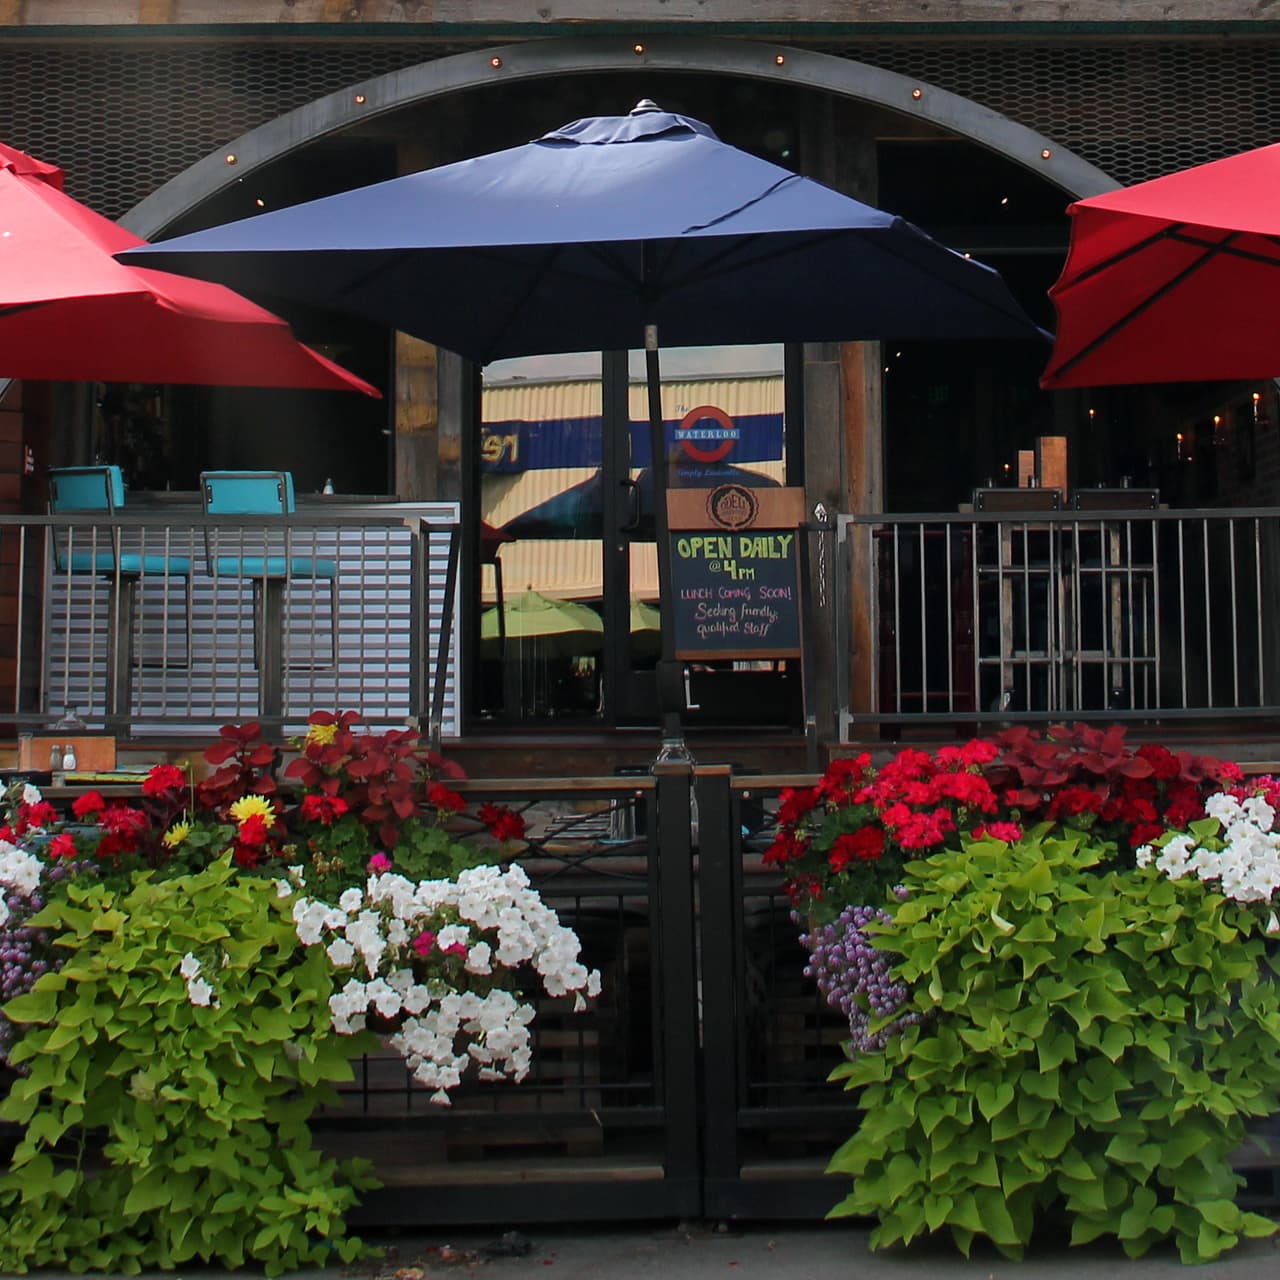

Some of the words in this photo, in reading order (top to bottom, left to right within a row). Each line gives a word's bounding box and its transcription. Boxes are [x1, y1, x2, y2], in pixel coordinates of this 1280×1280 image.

[678, 430, 737, 439] WATERLOO
[677, 536, 733, 559] OPEN
[739, 535, 793, 559] DAILY
